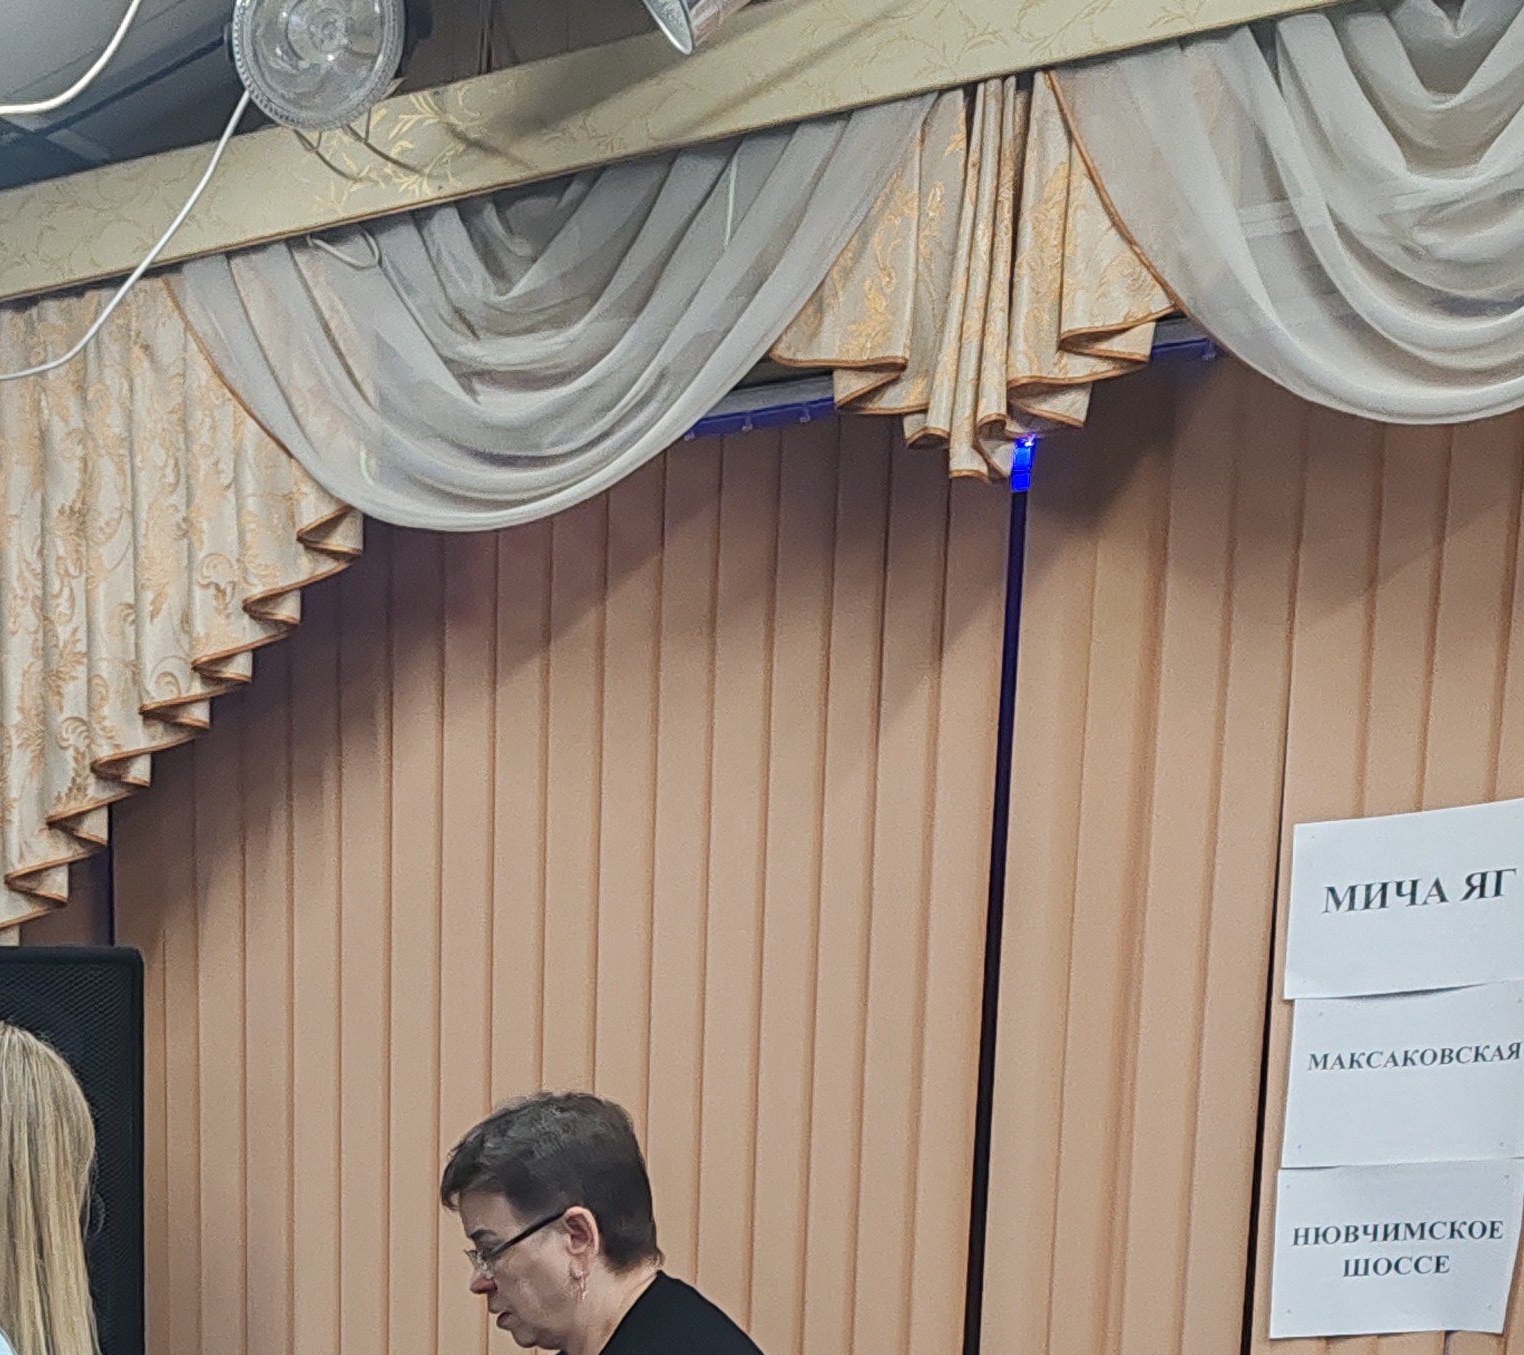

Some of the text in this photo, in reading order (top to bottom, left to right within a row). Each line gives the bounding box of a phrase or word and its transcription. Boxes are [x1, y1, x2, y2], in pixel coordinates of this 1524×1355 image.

[1322, 867, 1517, 915] МИЧА ЯГ
[1307, 1041, 1522, 1072] МАКСАКОВСКАЯ
[1292, 1219, 1504, 1248] НЮВЧИМСКОЕ
[1342, 1255, 1451, 1278] ШОССЕ
